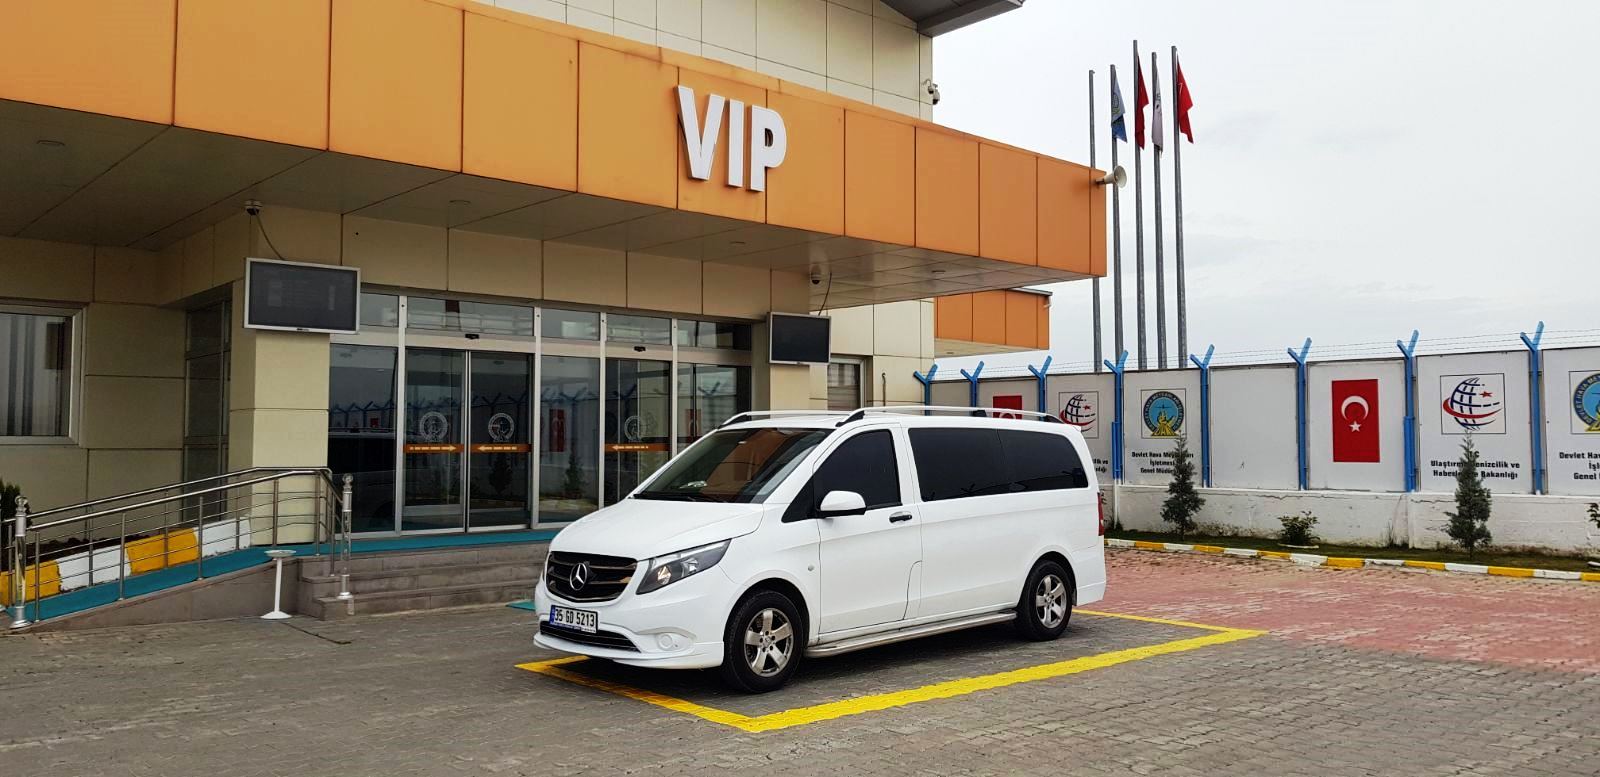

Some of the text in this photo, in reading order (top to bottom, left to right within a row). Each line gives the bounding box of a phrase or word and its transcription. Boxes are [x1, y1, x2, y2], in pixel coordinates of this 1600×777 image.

[674, 85, 787, 192] VIP
[1559, 451, 1585, 459] Devlet
[1430, 460, 1464, 469] Ulaştırm
[1433, 470, 1518, 480] Haberlee Bakanlığı
[1573, 472, 1597, 480] Genel
[555, 609, 563, 621] 35
[565, 610, 574, 624] GD
[576, 612, 594, 627] 5213
